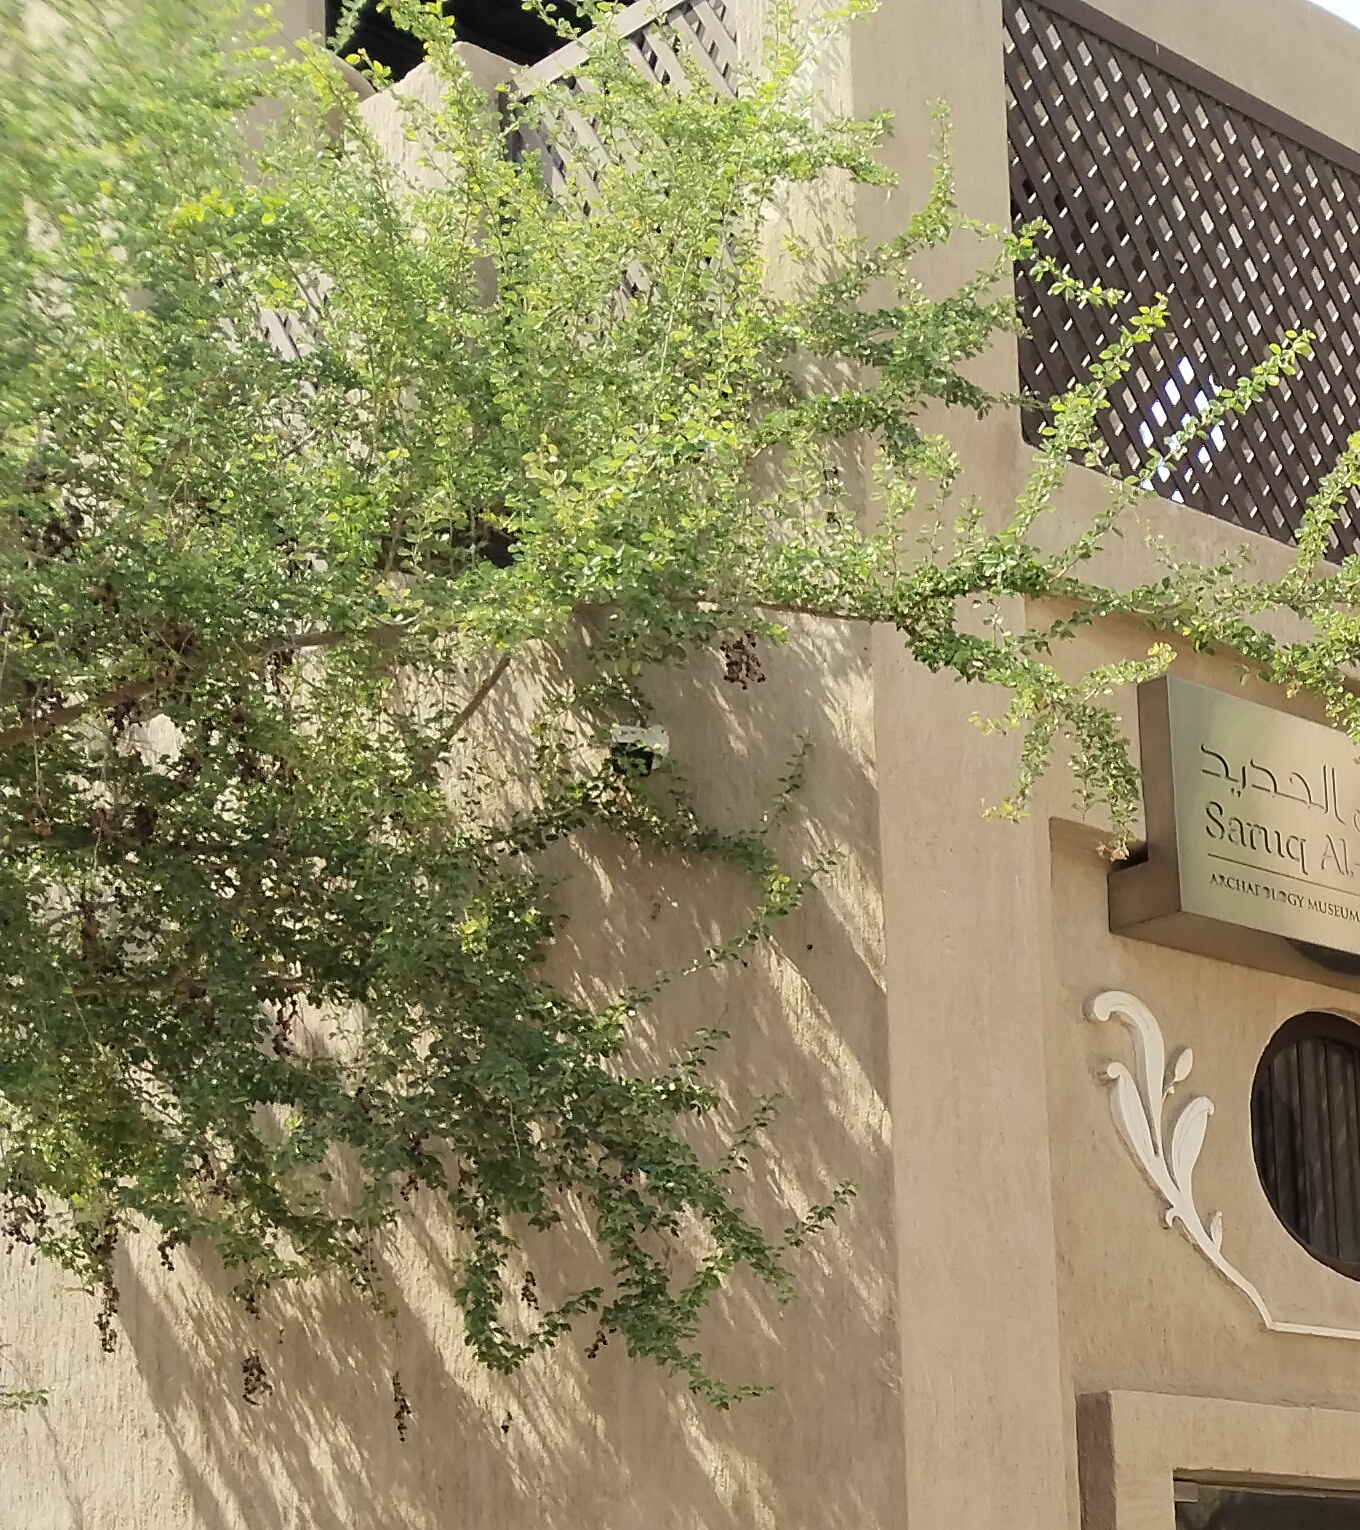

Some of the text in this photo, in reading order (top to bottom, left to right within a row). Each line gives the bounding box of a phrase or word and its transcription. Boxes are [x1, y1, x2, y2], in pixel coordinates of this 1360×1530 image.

[1200, 743, 1347, 825] الحديد
[1204, 800, 1309, 876] Saruq
[1208, 873, 1360, 924] ARCHAEOLOGY MUSEUM
